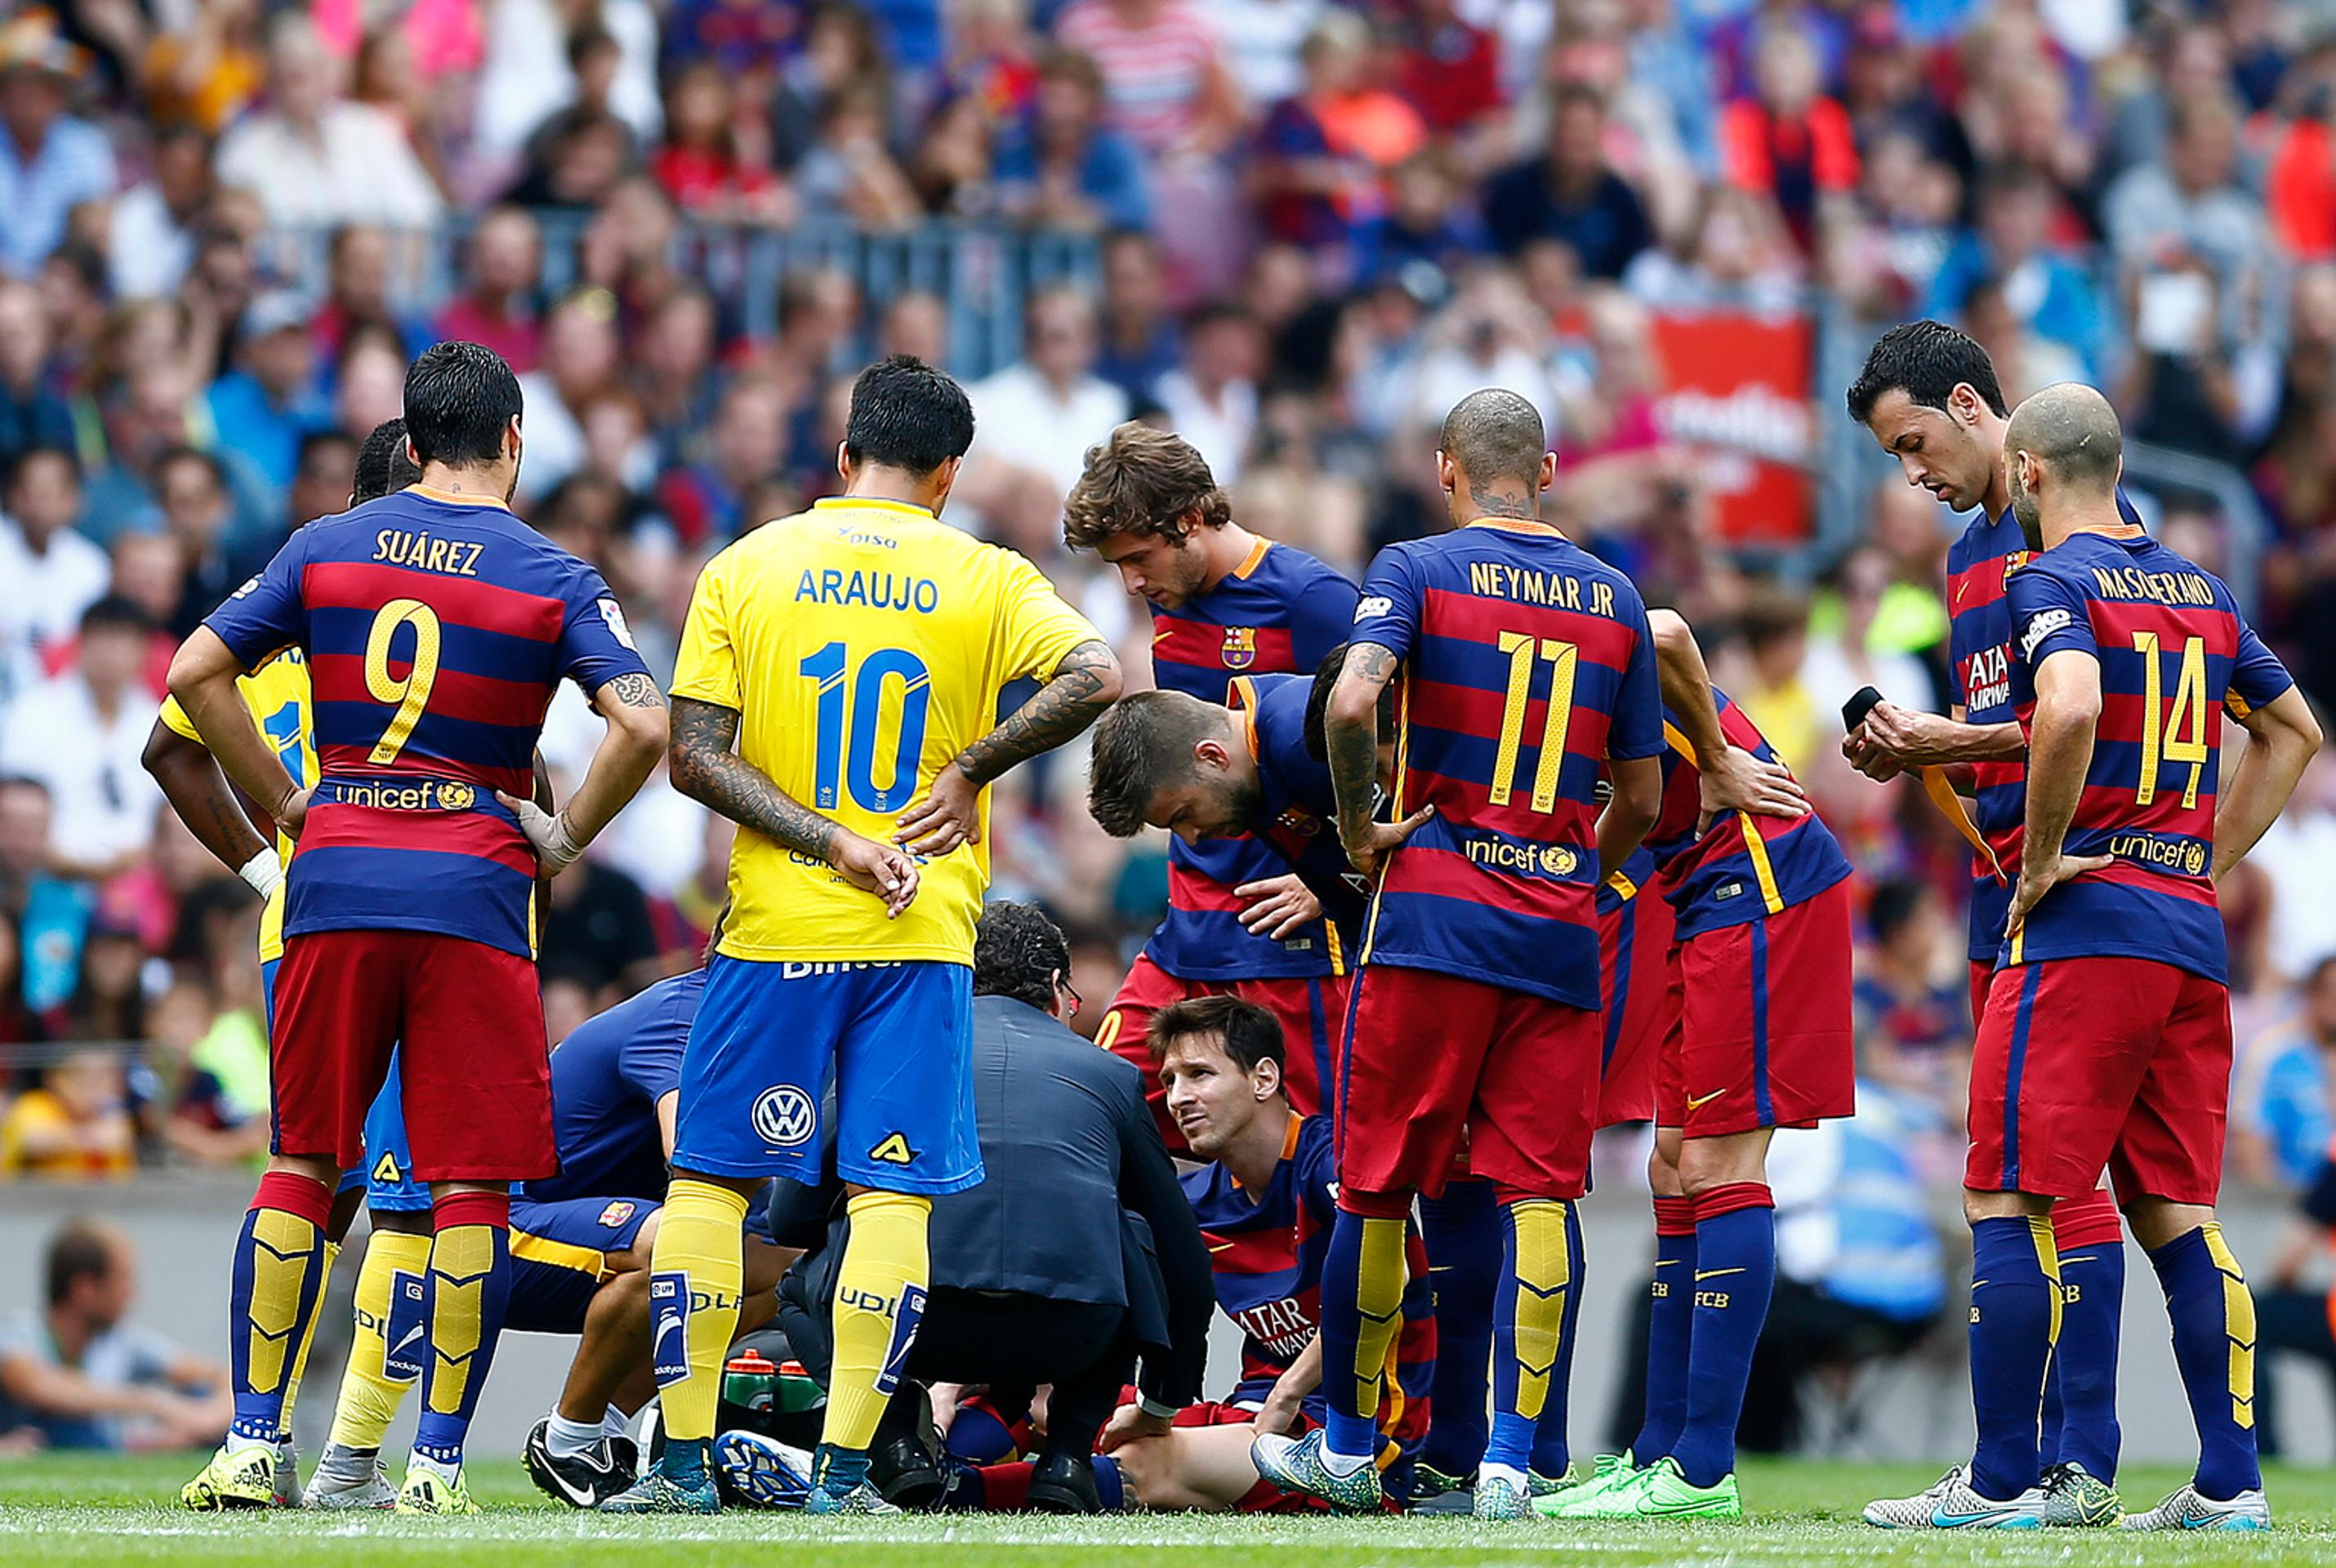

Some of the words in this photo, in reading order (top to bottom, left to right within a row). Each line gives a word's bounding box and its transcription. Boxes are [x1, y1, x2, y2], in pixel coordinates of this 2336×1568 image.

[372, 529, 484, 576] SUÁREZ
[795, 569, 938, 613] ARAUJO
[1470, 562, 1581, 610] NEYMAR
[1589, 581, 1615, 618] JR
[365, 598, 440, 764] 9
[800, 642, 931, 813] 10
[1489, 630, 1577, 814] 11
[2132, 631, 2208, 809] 14
[336, 781, 433, 808] unicef
[2111, 833, 2187, 867] unicef
[1239, 1298, 1312, 1339] ATAR
[1694, 1291, 1730, 1308] FCB
